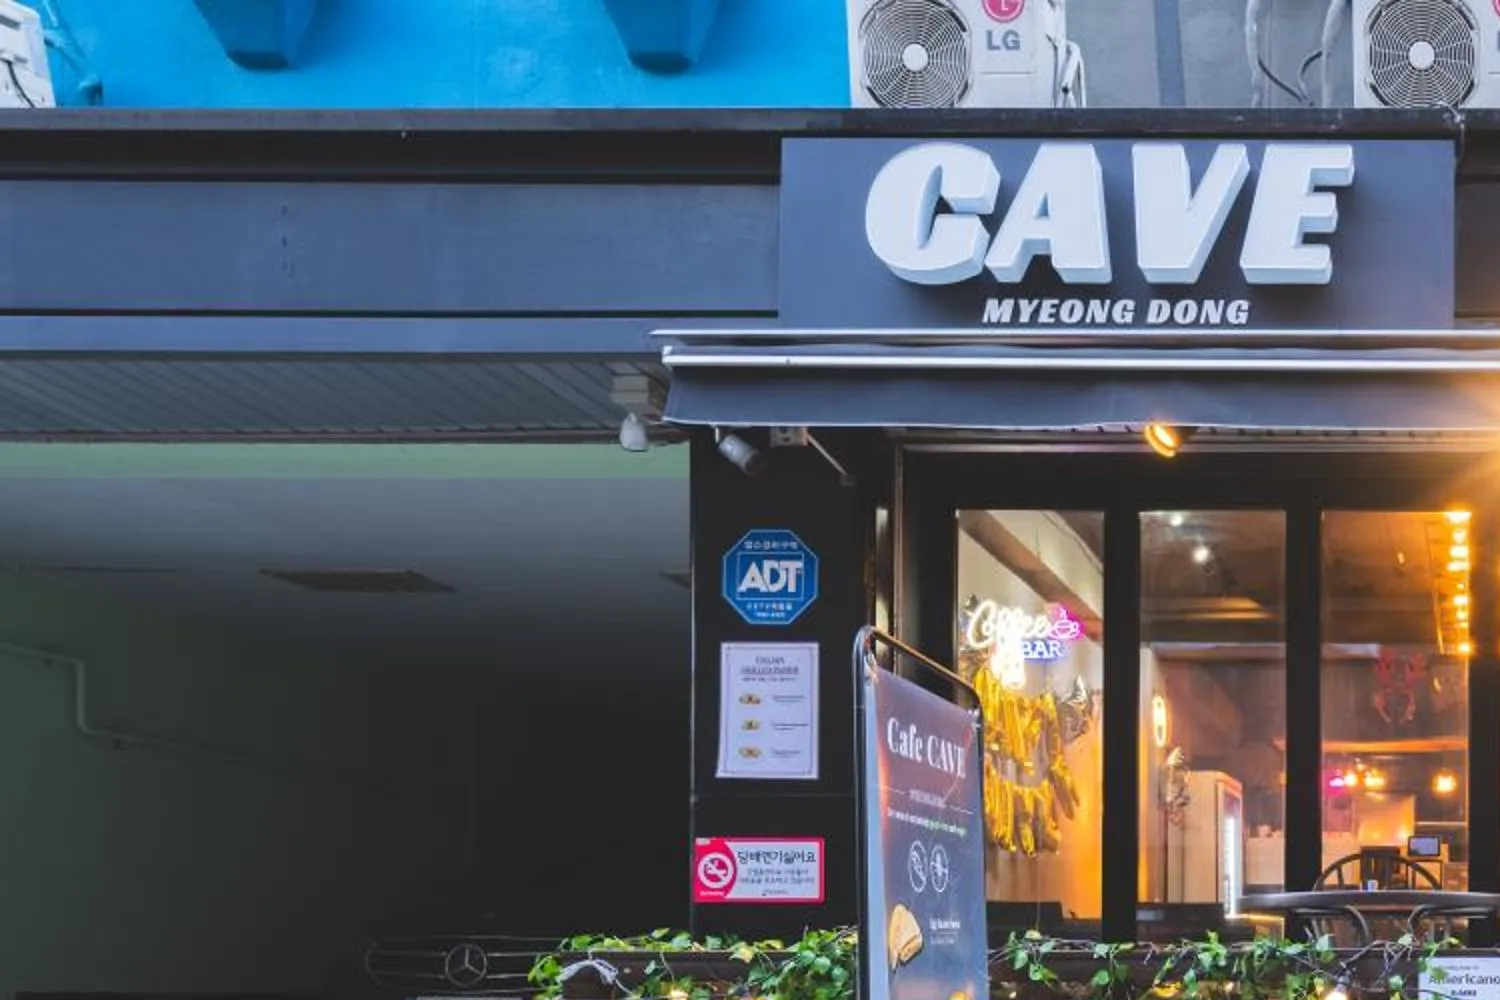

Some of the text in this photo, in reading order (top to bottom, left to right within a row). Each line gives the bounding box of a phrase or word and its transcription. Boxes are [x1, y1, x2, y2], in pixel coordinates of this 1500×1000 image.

[986, 29, 1020, 51] LG
[864, 142, 1355, 286] CAVE
[982, 298, 1250, 325] MYEONG DONG
[737, 559, 804, 593] ADT
[887, 717, 967, 780] Cafe CAVE
